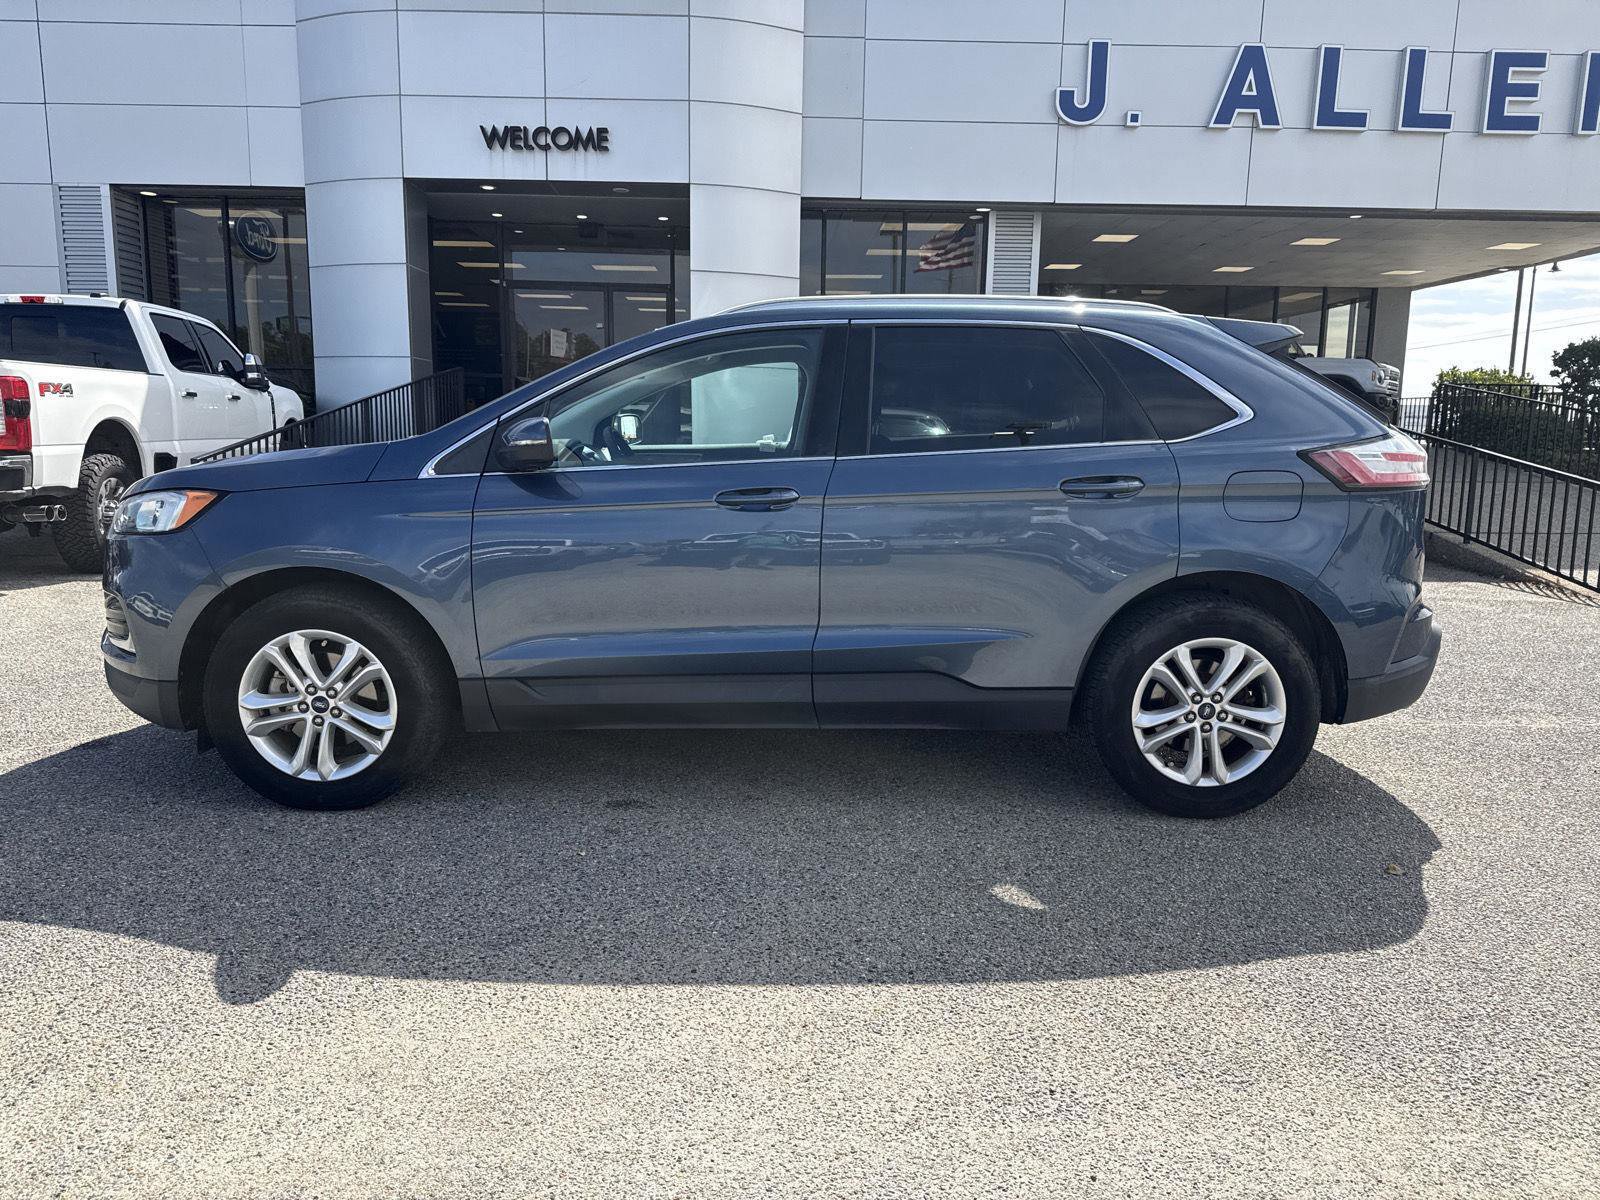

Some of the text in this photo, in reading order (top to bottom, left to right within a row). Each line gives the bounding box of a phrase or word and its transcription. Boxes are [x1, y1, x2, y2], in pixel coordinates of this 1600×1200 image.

[1055, 38, 1600, 136] J. ALLE
[479, 124, 610, 152] WELCOME
[38, 382, 73, 396] FX4
